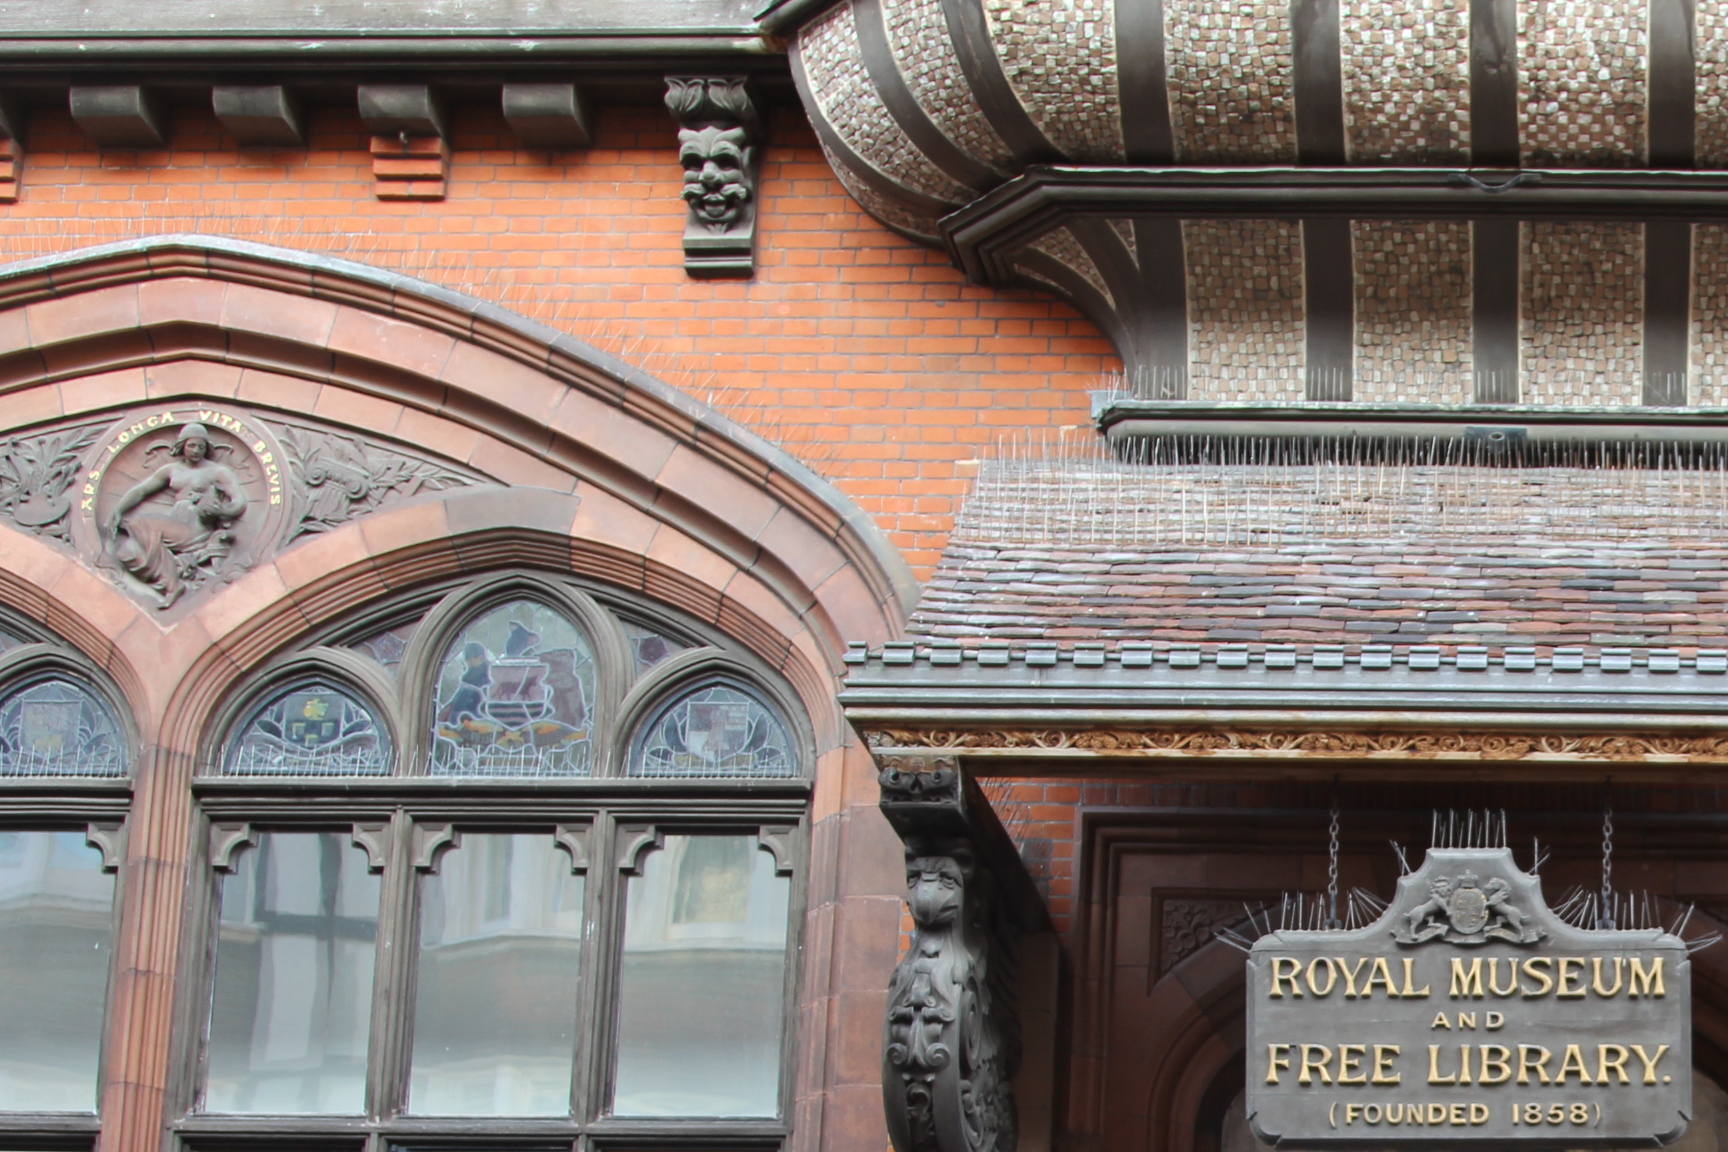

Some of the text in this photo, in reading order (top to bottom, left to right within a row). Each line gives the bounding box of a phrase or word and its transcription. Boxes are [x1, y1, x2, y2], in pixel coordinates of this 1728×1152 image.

[81, 409, 281, 511] ARS LONGA VITA BREVIS
[1269, 956, 1667, 998] ROYAL MUSEUM
[1431, 1011, 1505, 1029] AND
[1265, 1044, 1672, 1085] FREE LIBRARY.
[1329, 1102, 1601, 1128] (FOUNDED 1858)
